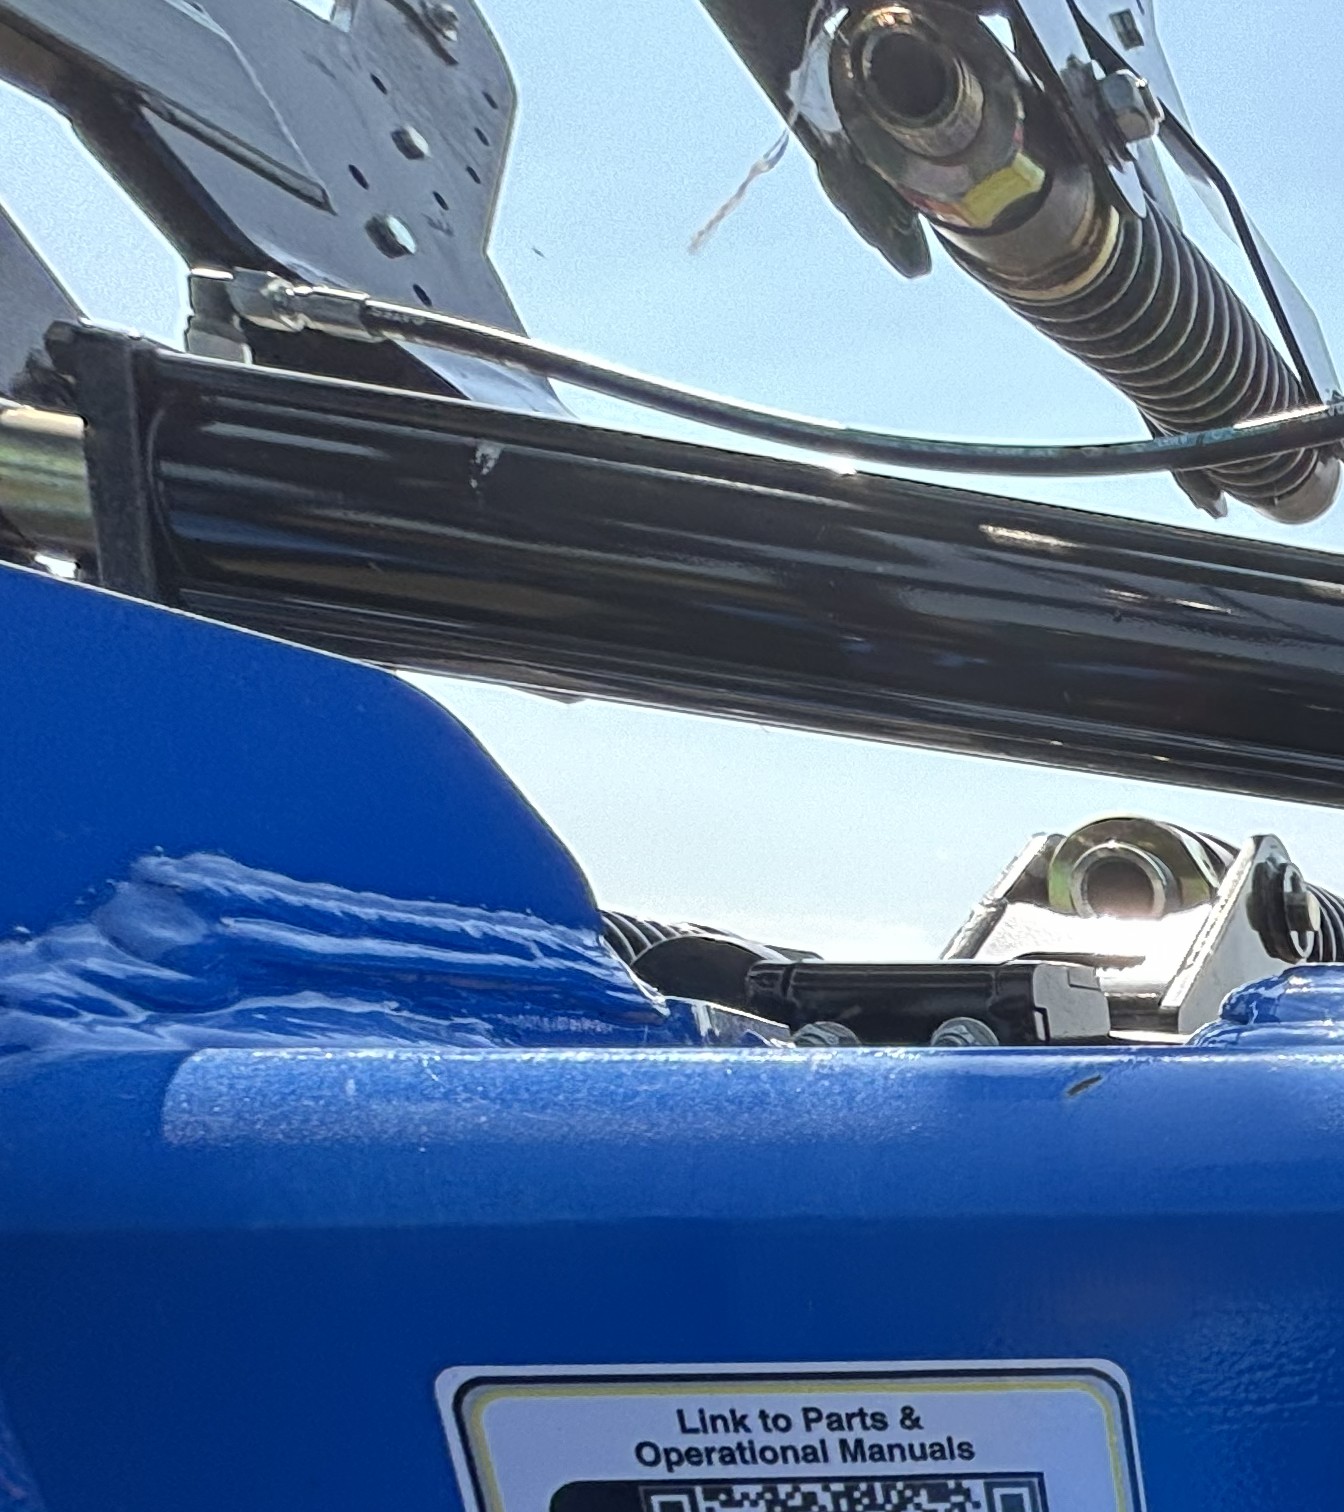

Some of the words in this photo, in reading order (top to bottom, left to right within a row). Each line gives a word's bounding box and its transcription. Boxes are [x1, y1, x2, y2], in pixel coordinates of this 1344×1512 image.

[676, 1407, 753, 1435] Link
[758, 1408, 793, 1434] to
[801, 1406, 890, 1433] Parts
[899, 1404, 924, 1431] &
[635, 1438, 829, 1473] Operational
[839, 1435, 976, 1463] Manuals
